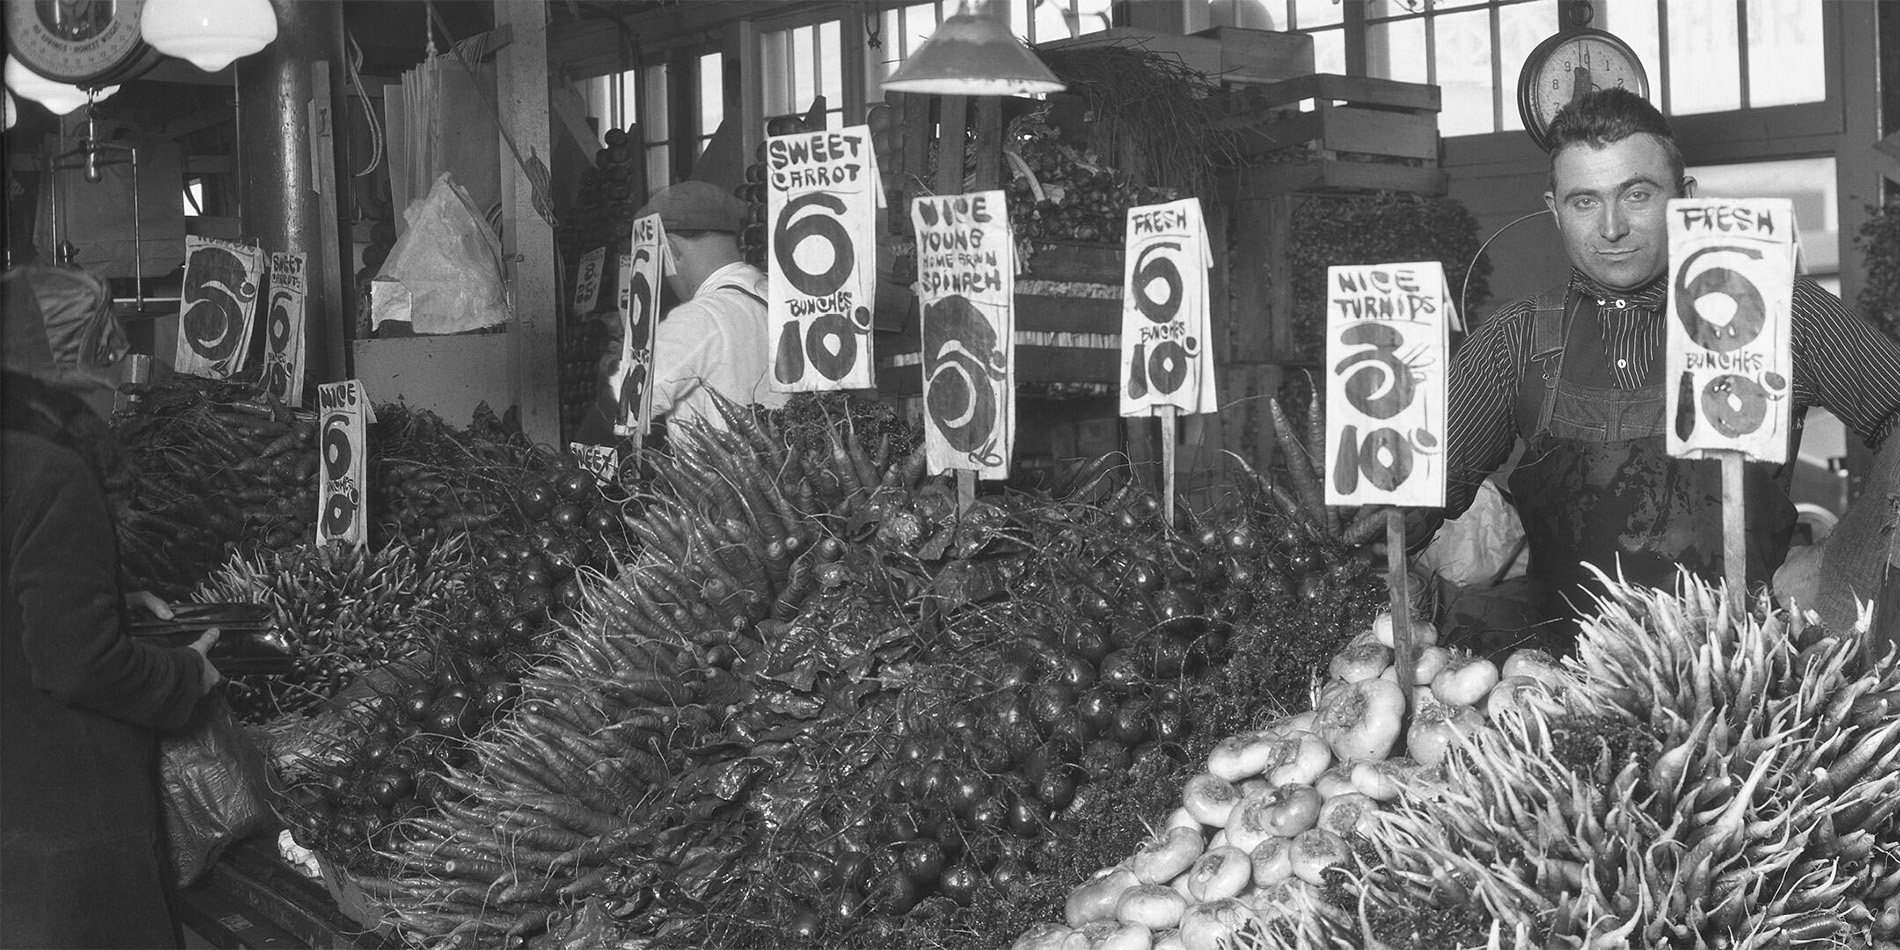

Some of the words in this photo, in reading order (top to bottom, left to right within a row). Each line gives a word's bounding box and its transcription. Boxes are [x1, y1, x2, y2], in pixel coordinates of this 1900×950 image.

[1564, 60, 1571, 73] 9
[1605, 59, 1611, 71] 1
[1552, 78, 1559, 90] 8
[769, 133, 862, 170] SWEET
[771, 163, 861, 191] CARROT
[919, 196, 992, 227] NICE
[1131, 207, 1187, 236] FRESH
[1676, 206, 1774, 236] FRESH
[774, 191, 854, 297] 6
[920, 228, 984, 254] YOUNG
[272, 255, 302, 274] SWEET
[922, 252, 954, 269] HOME
[921, 268, 1001, 297] SPINACH
[1131, 241, 1184, 324] 6
[1337, 269, 1420, 294] NICE
[785, 291, 853, 317] BUNCHES
[1332, 294, 1436, 322] TURNIPS
[1675, 245, 1766, 353] 6
[269, 291, 293, 354] 6
[1334, 322, 1416, 420] 3
[1685, 351, 1764, 374] BUNCHES
[320, 382, 356, 408] NICE
[323, 414, 351, 481] 6
